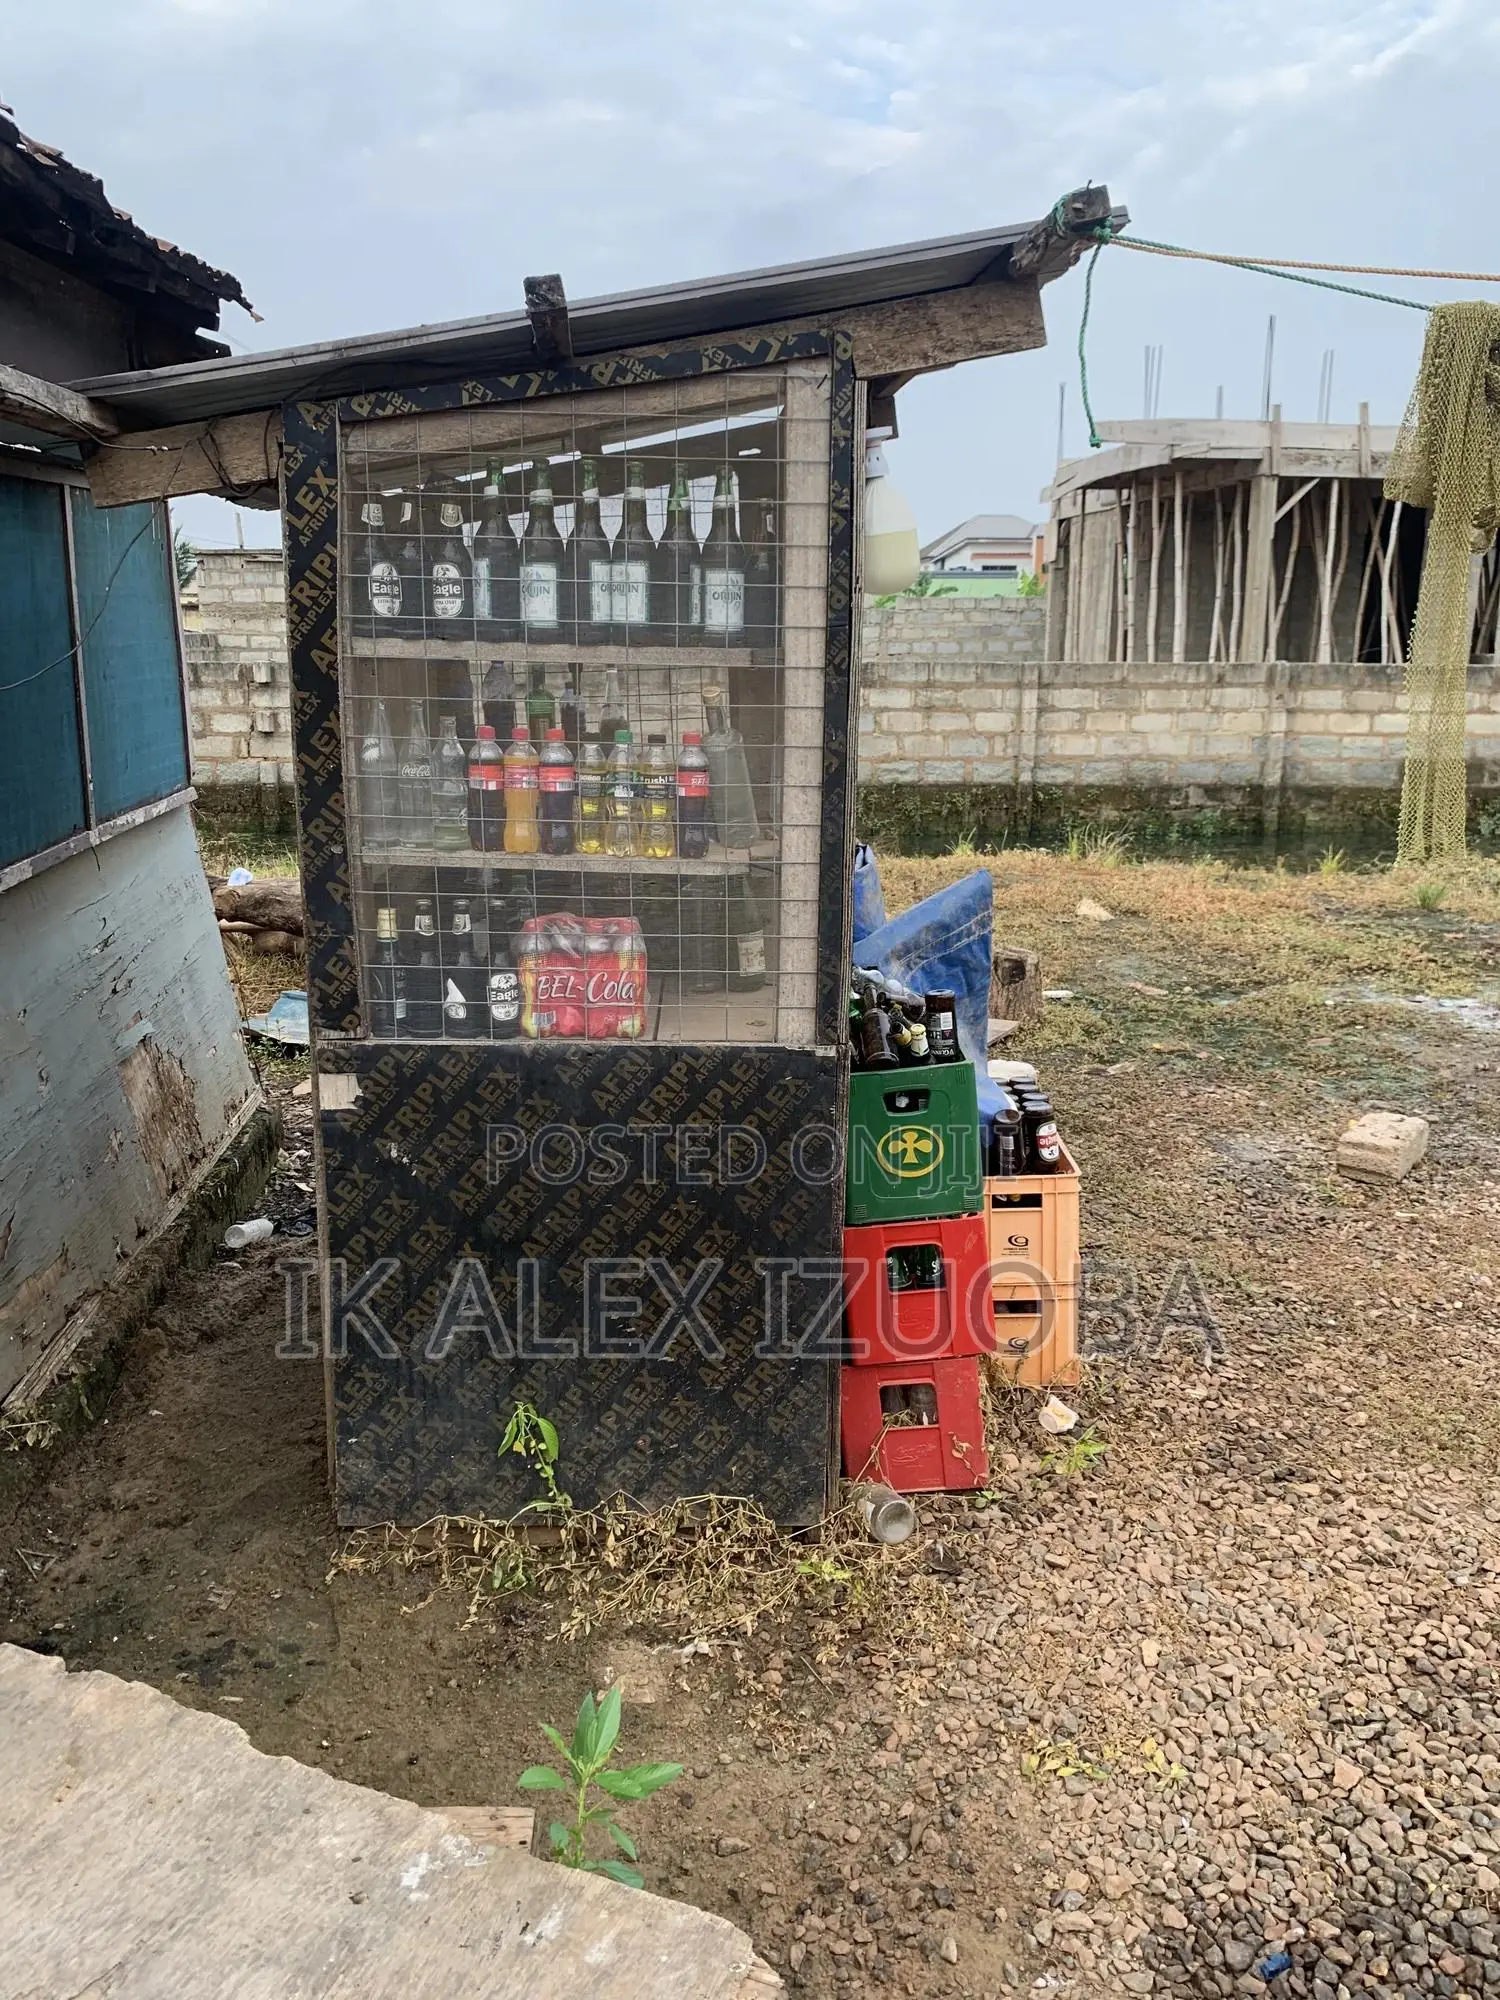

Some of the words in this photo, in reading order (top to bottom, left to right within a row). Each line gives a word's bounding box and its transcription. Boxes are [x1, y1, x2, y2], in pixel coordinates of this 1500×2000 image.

[286, 465, 338, 531] LEX
[290, 584, 337, 651] AFRIPLEX
[713, 591, 742, 605] ORIJIN
[645, 774, 668, 786] rush!
[490, 988, 520, 1002] Eagle
[440, 1048, 487, 1105] AFRIPLEX
[478, 1073, 526, 1133] AFRIPLEX
[607, 1061, 655, 1120] AFRIPLEX
[730, 1055, 778, 1110] AFRIPLEX
[352, 1083, 401, 1139] AFRIPLEX
[416, 1063, 518, 1187] AFRIPLEX
[767, 1083, 814, 1136] AFRIPLEX
[327, 1163, 374, 1215] LEX
[428, 1139, 476, 1192] AFRIPLEX
[336, 1179, 384, 1230] AFRIPLEX
[374, 1200, 421, 1257] AFRIPLEX
[501, 1192, 548, 1244] AFRIPLEX
[625, 1180, 671, 1235] AFRIPLEX
[659, 1208, 707, 1261] AFRIPLEX
